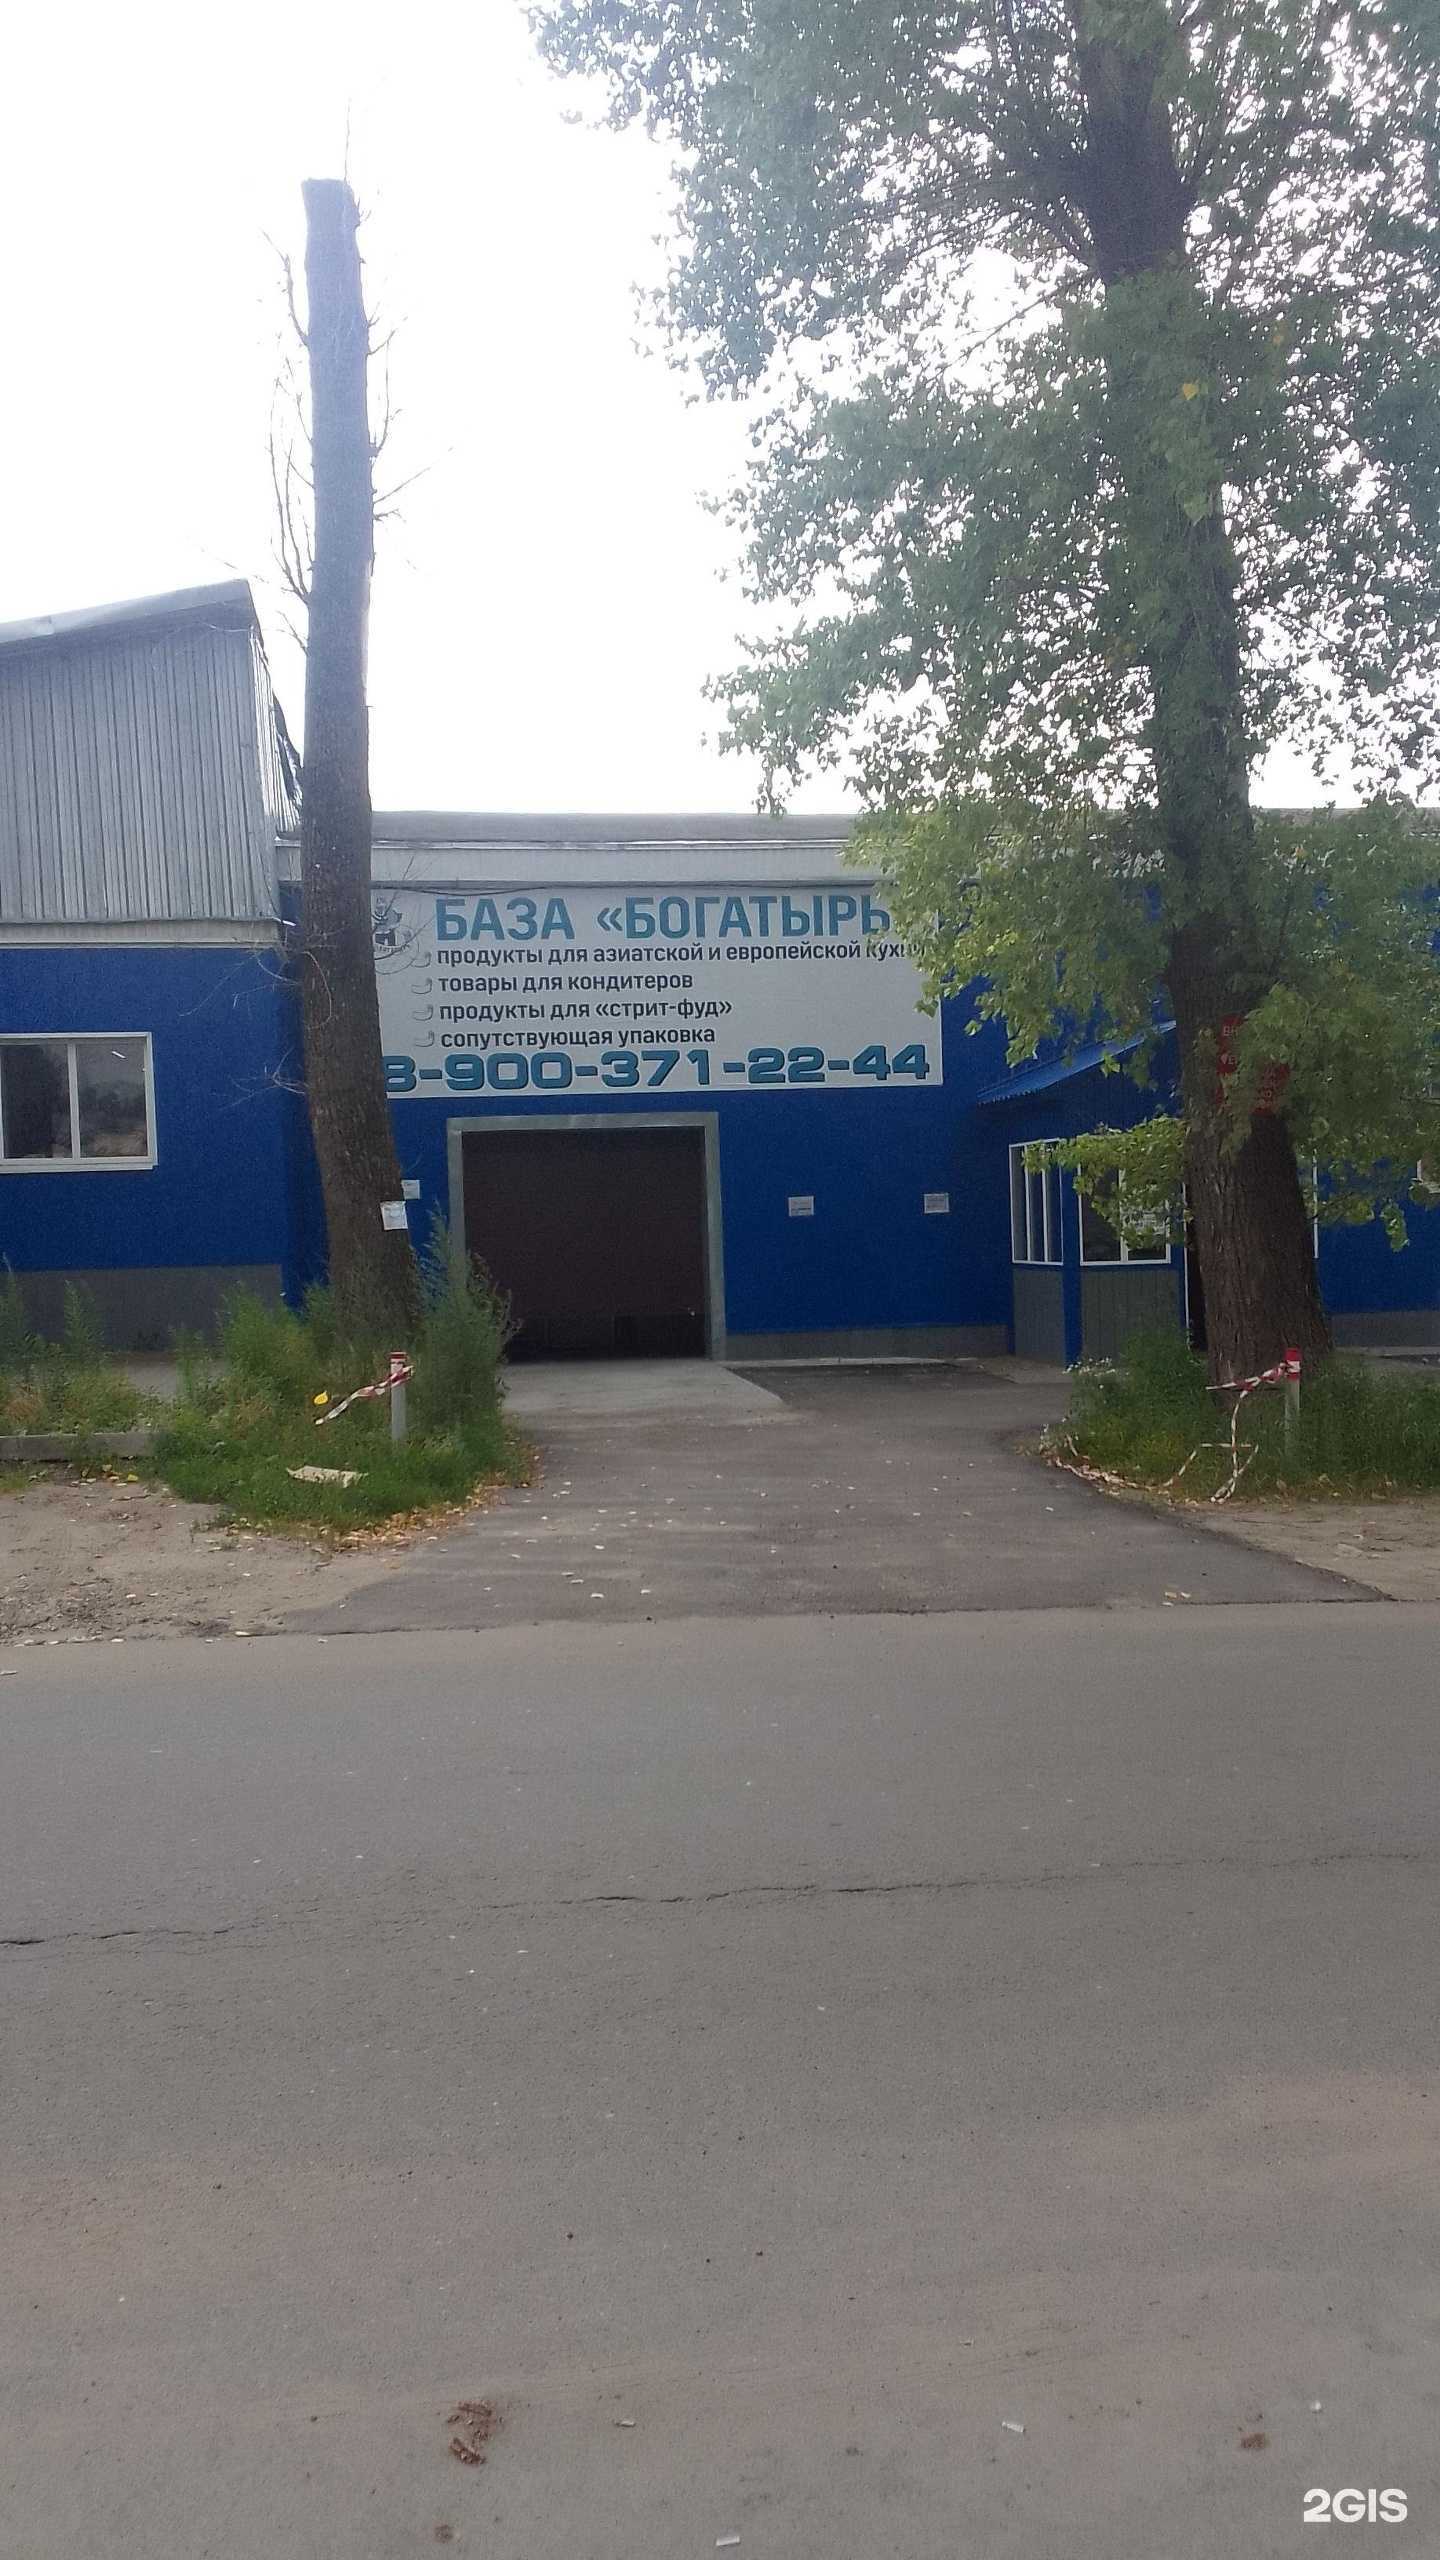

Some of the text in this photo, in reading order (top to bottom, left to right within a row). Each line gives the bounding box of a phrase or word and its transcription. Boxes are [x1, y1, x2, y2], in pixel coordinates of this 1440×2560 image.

[435, 896, 575, 941] БАЗА
[437, 949, 543, 967] продукты
[547, 949, 588, 965] для
[593, 943, 703, 962] азиатской
[708, 947, 721, 960] и
[726, 939, 861, 963] европейской
[438, 974, 693, 995] товары для кондитеров
[439, 998, 732, 1023] продукты для «стрит-фуд»
[441, 1028, 716, 1050] сопутствующая упаковка
